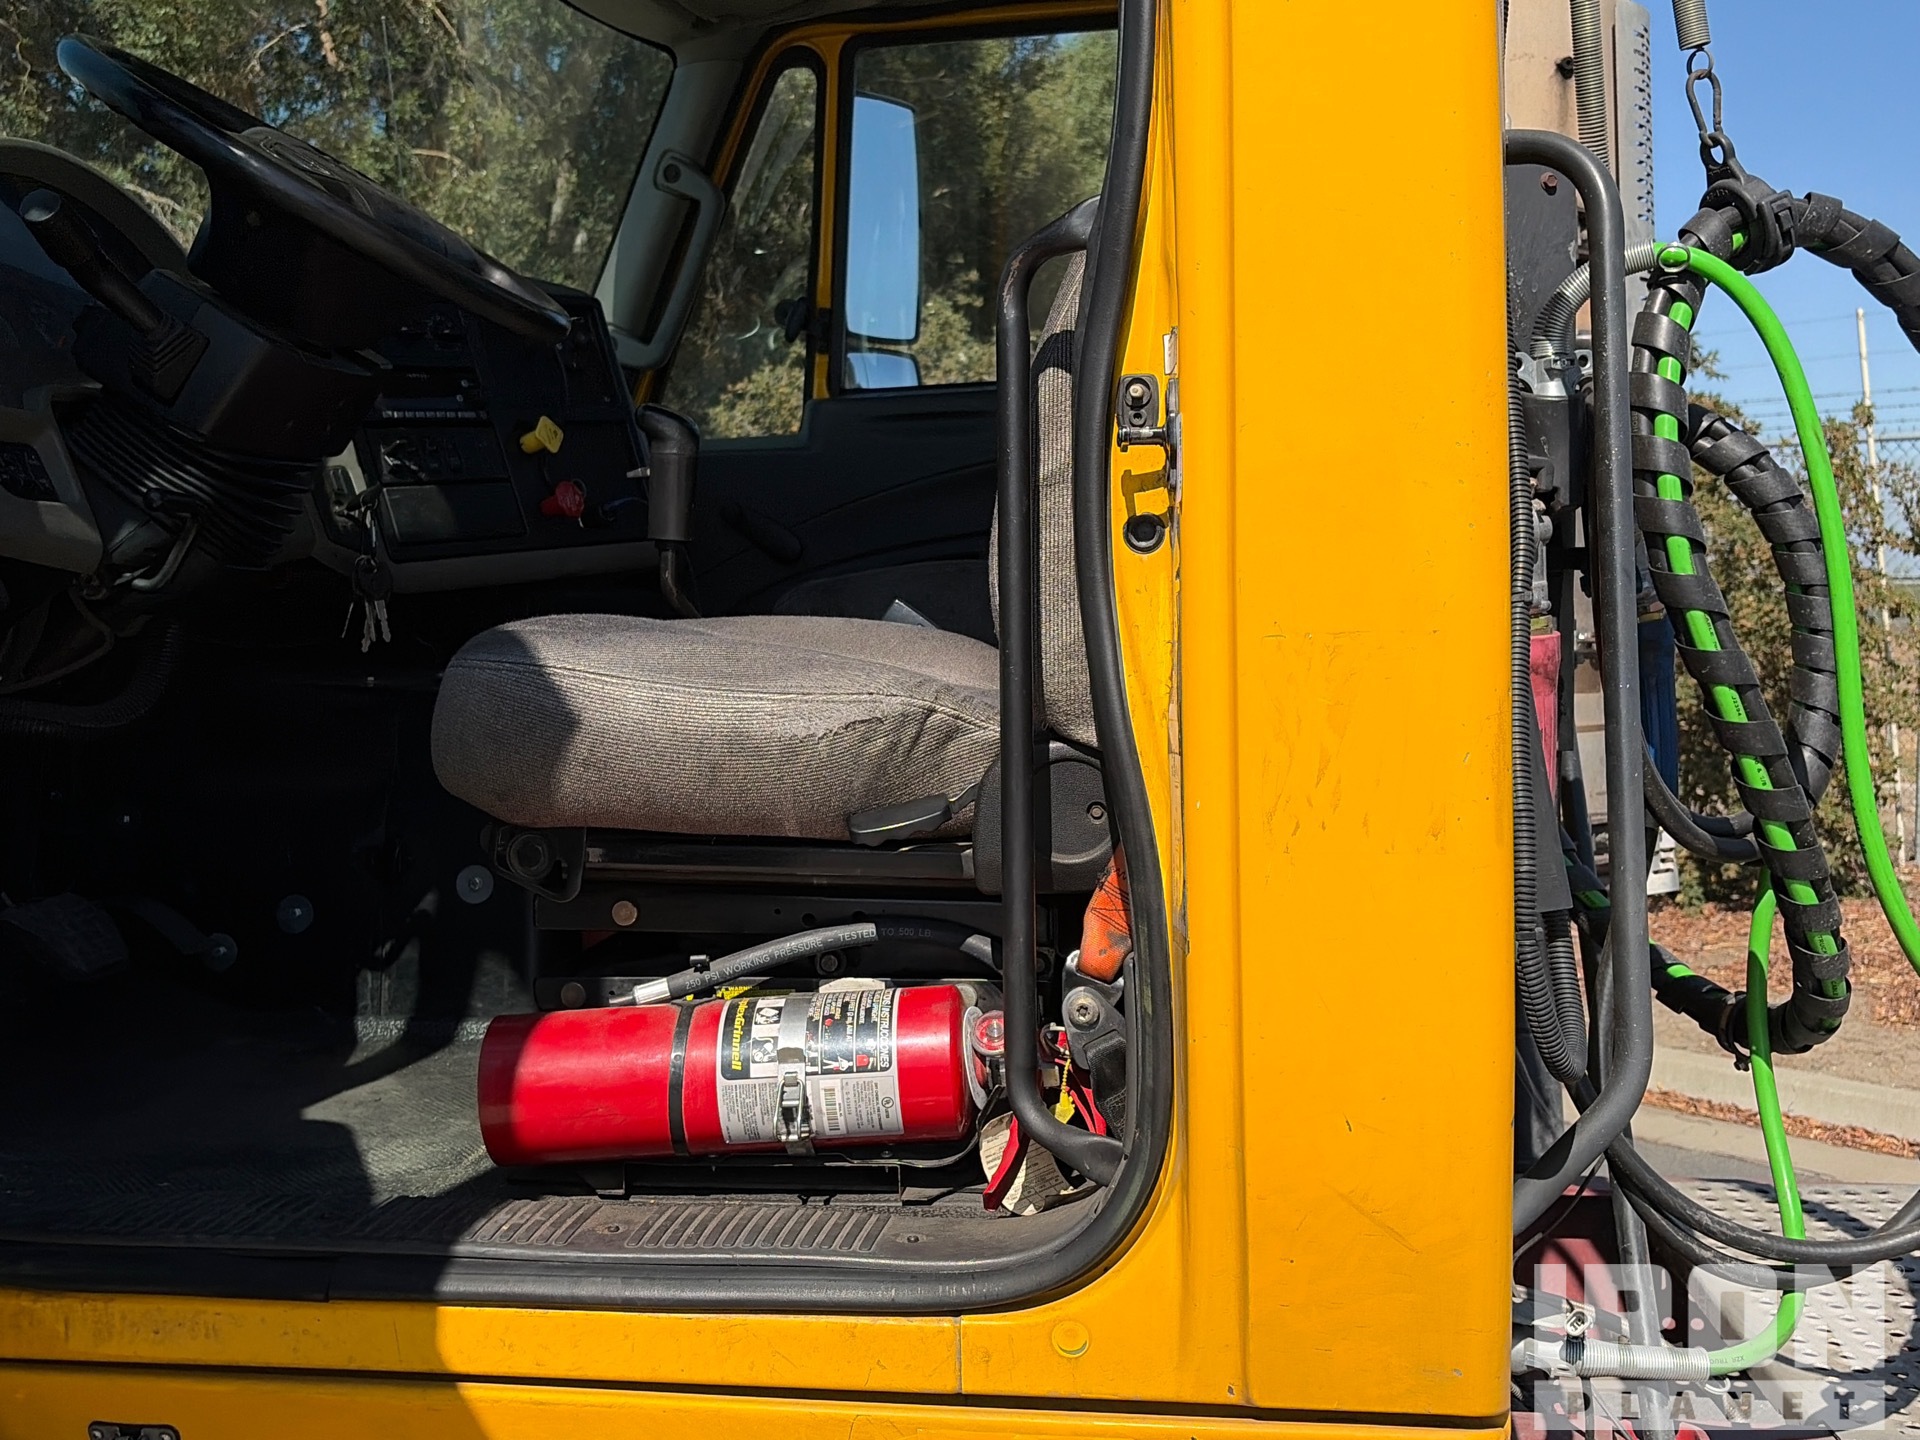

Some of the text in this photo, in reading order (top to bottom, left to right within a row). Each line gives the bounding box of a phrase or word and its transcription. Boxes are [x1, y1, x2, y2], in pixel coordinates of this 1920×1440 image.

[1731, 696, 1742, 717] J2394
[685, 978, 701, 990] 250
[705, 971, 721, 984] PSI
[723, 954, 770, 975] WORKING
[774, 939, 824, 960] PRESSURE
[838, 928, 877, 942] TESTED
[881, 928, 894, 936] TO
[899, 927, 915, 936] 500
